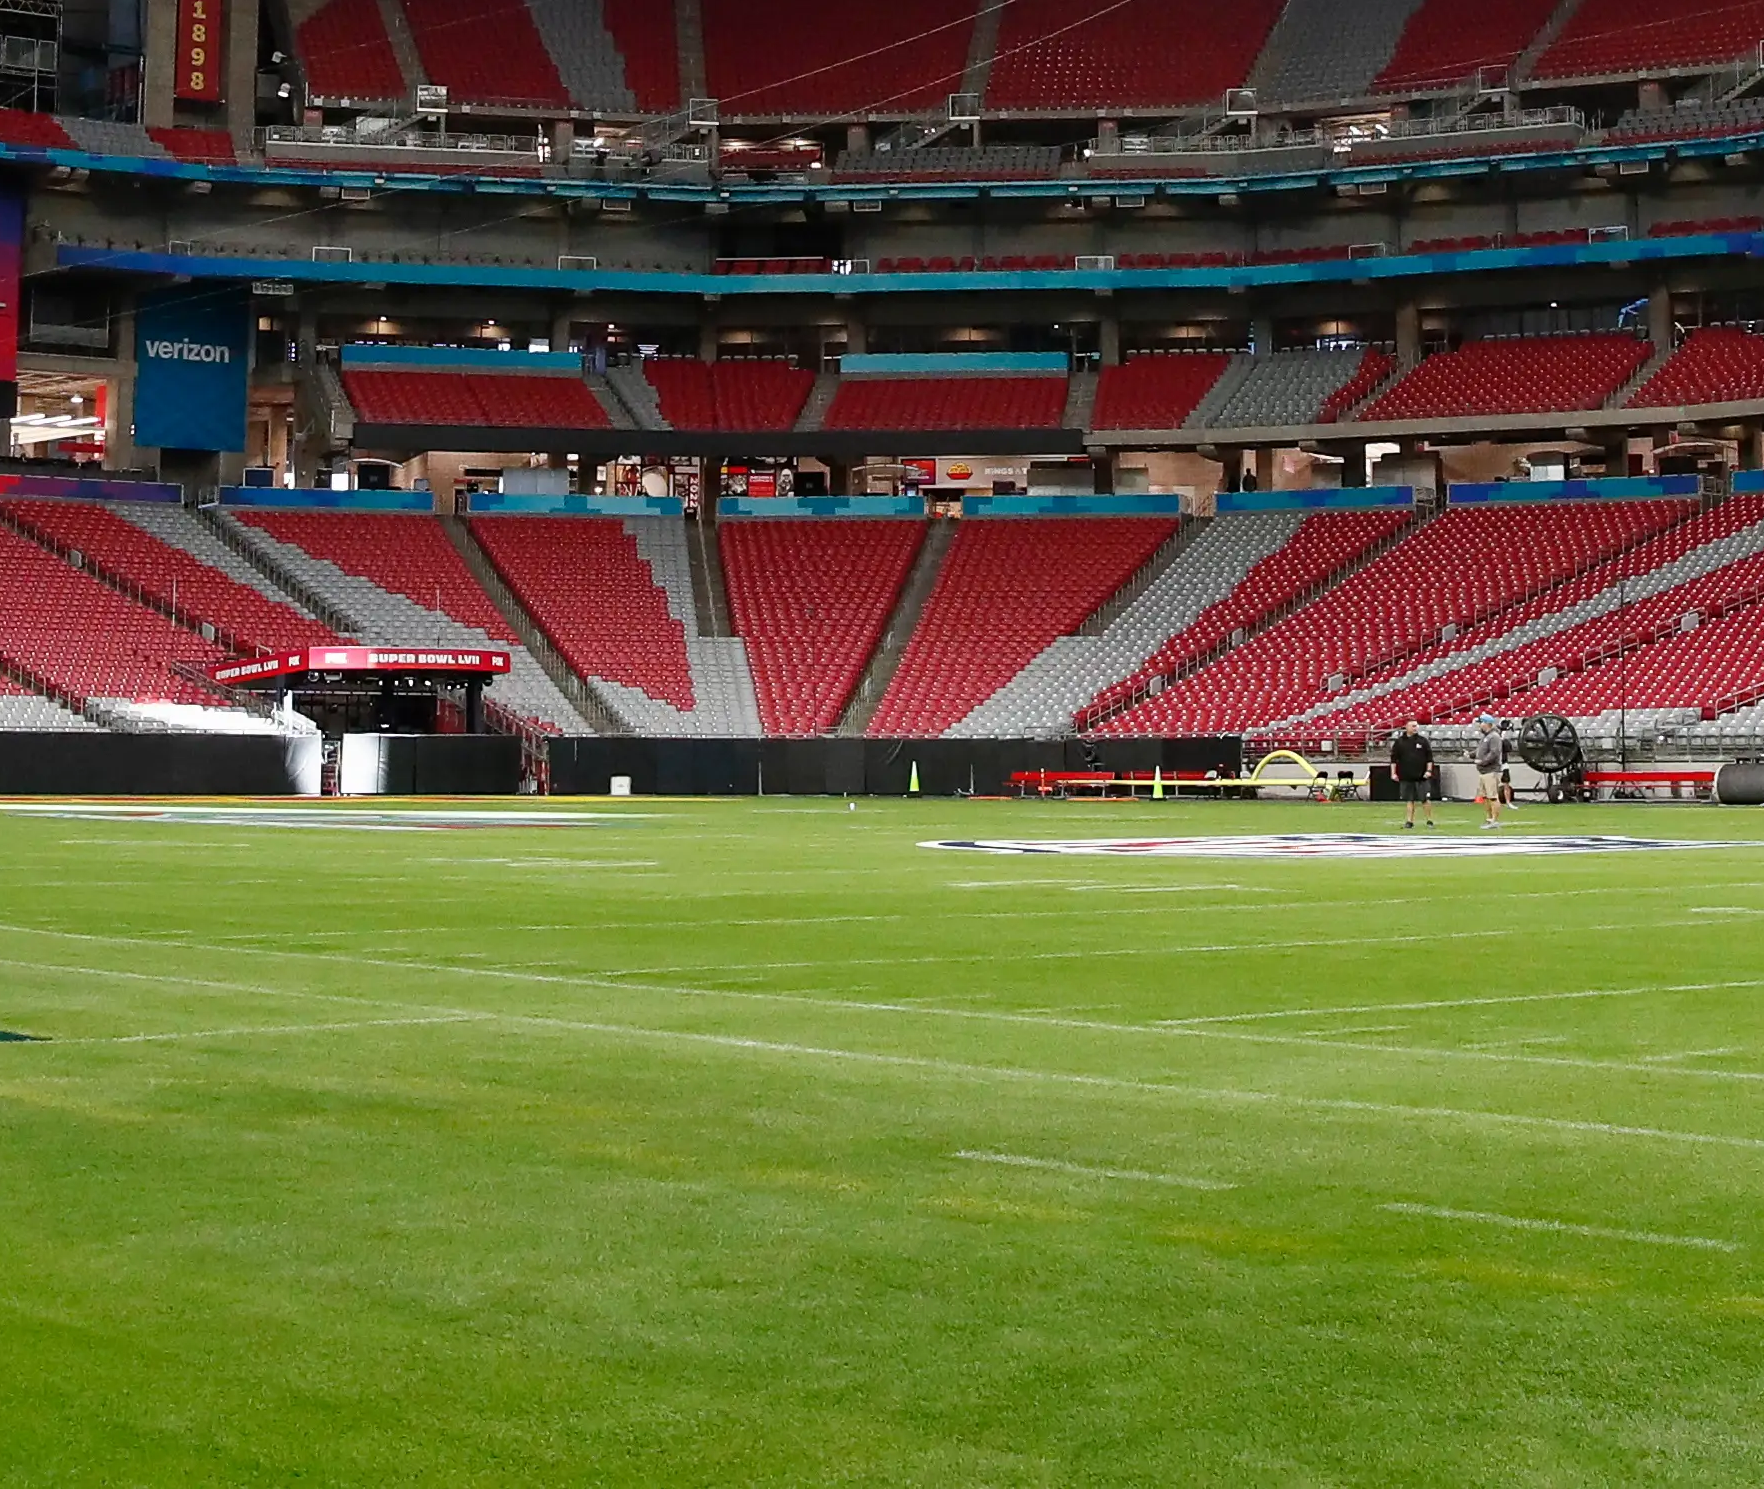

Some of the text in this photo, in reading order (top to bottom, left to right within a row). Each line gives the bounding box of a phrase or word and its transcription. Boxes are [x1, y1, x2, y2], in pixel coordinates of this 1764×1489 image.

[190, 0, 207, 91] 1898
[145, 338, 230, 363] verizon
[368, 653, 416, 664] SUPER
[418, 654, 456, 664] BOWL
[458, 655, 480, 665] LVII
[216, 667, 240, 680] SUPER
[241, 663, 262, 676] BOWL
